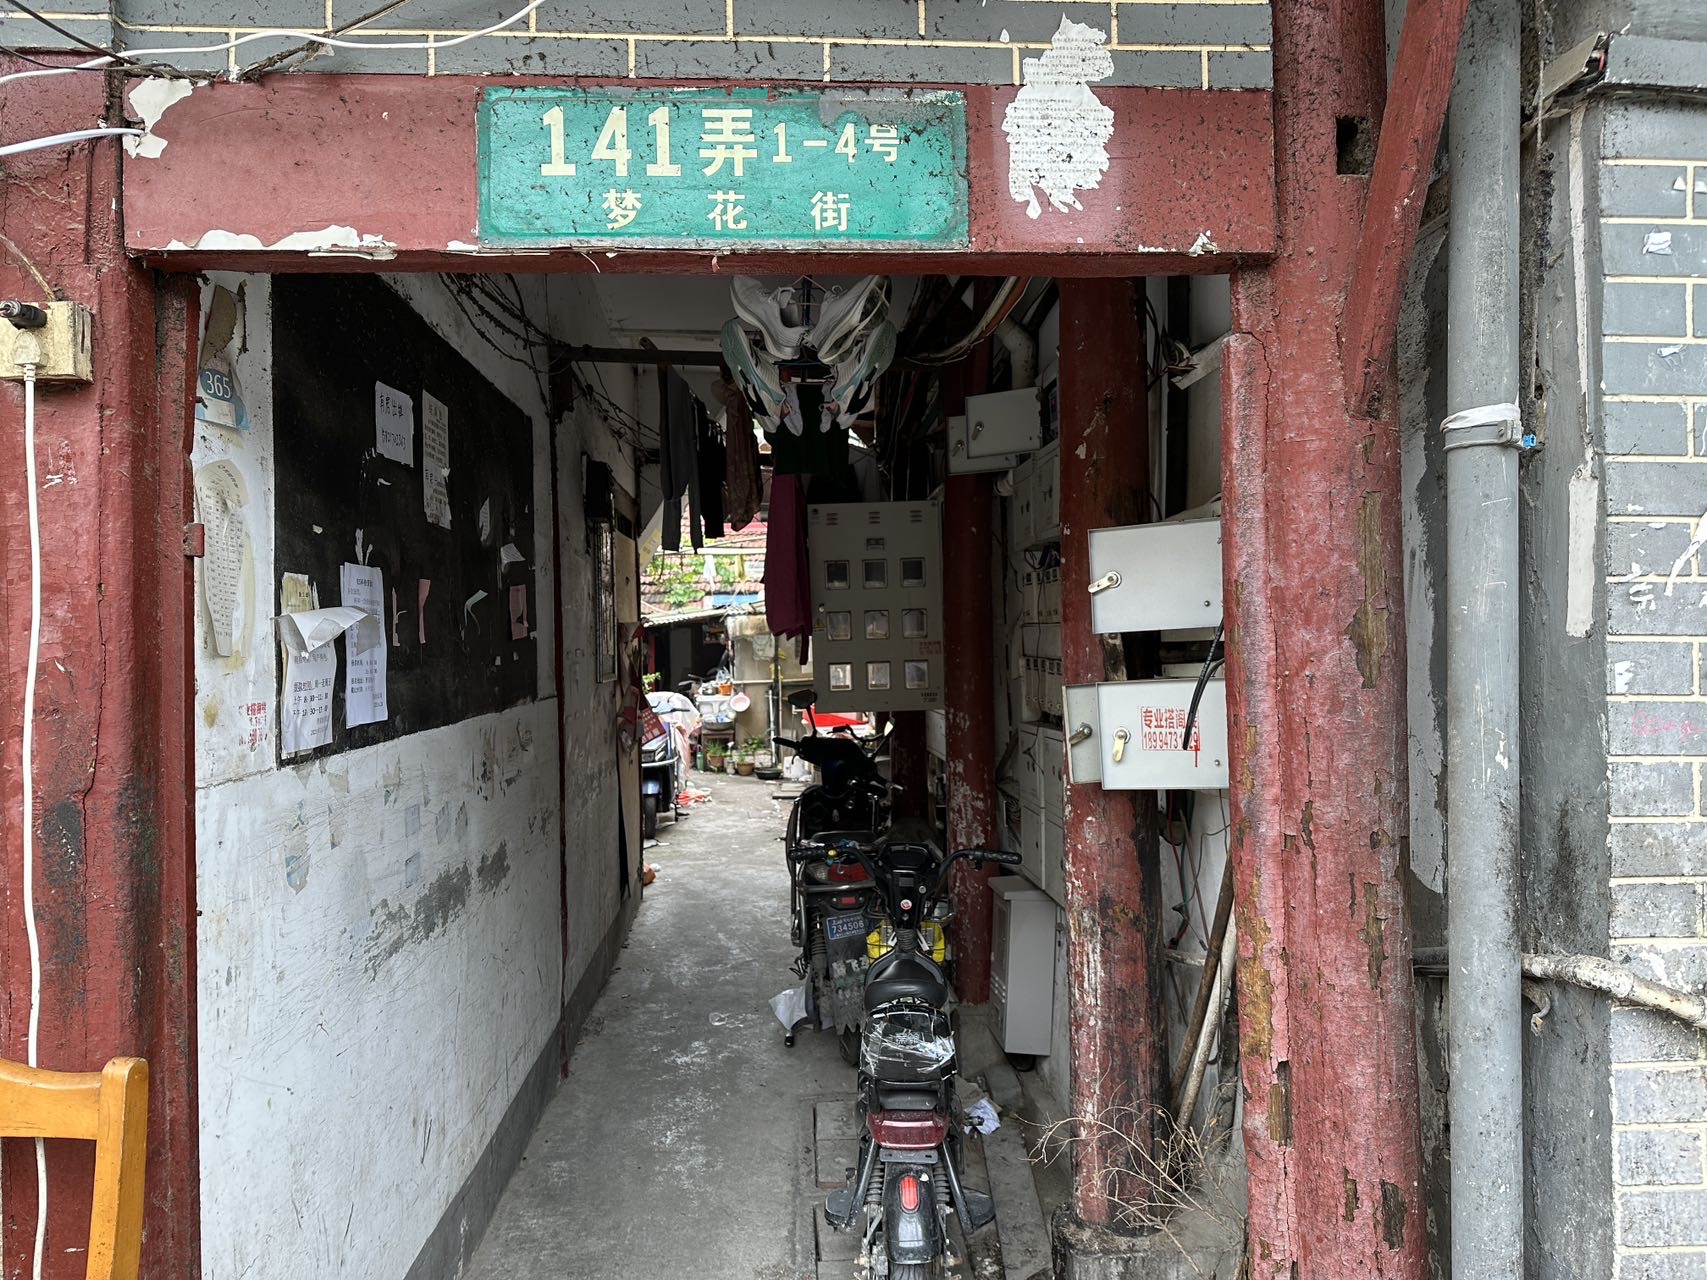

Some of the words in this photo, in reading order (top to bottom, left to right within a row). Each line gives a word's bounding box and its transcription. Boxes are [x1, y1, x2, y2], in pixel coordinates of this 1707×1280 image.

[602, 188, 850, 231] 梦花街
[205, 371, 231, 399] 365
[832, 920, 865, 934] 734506
